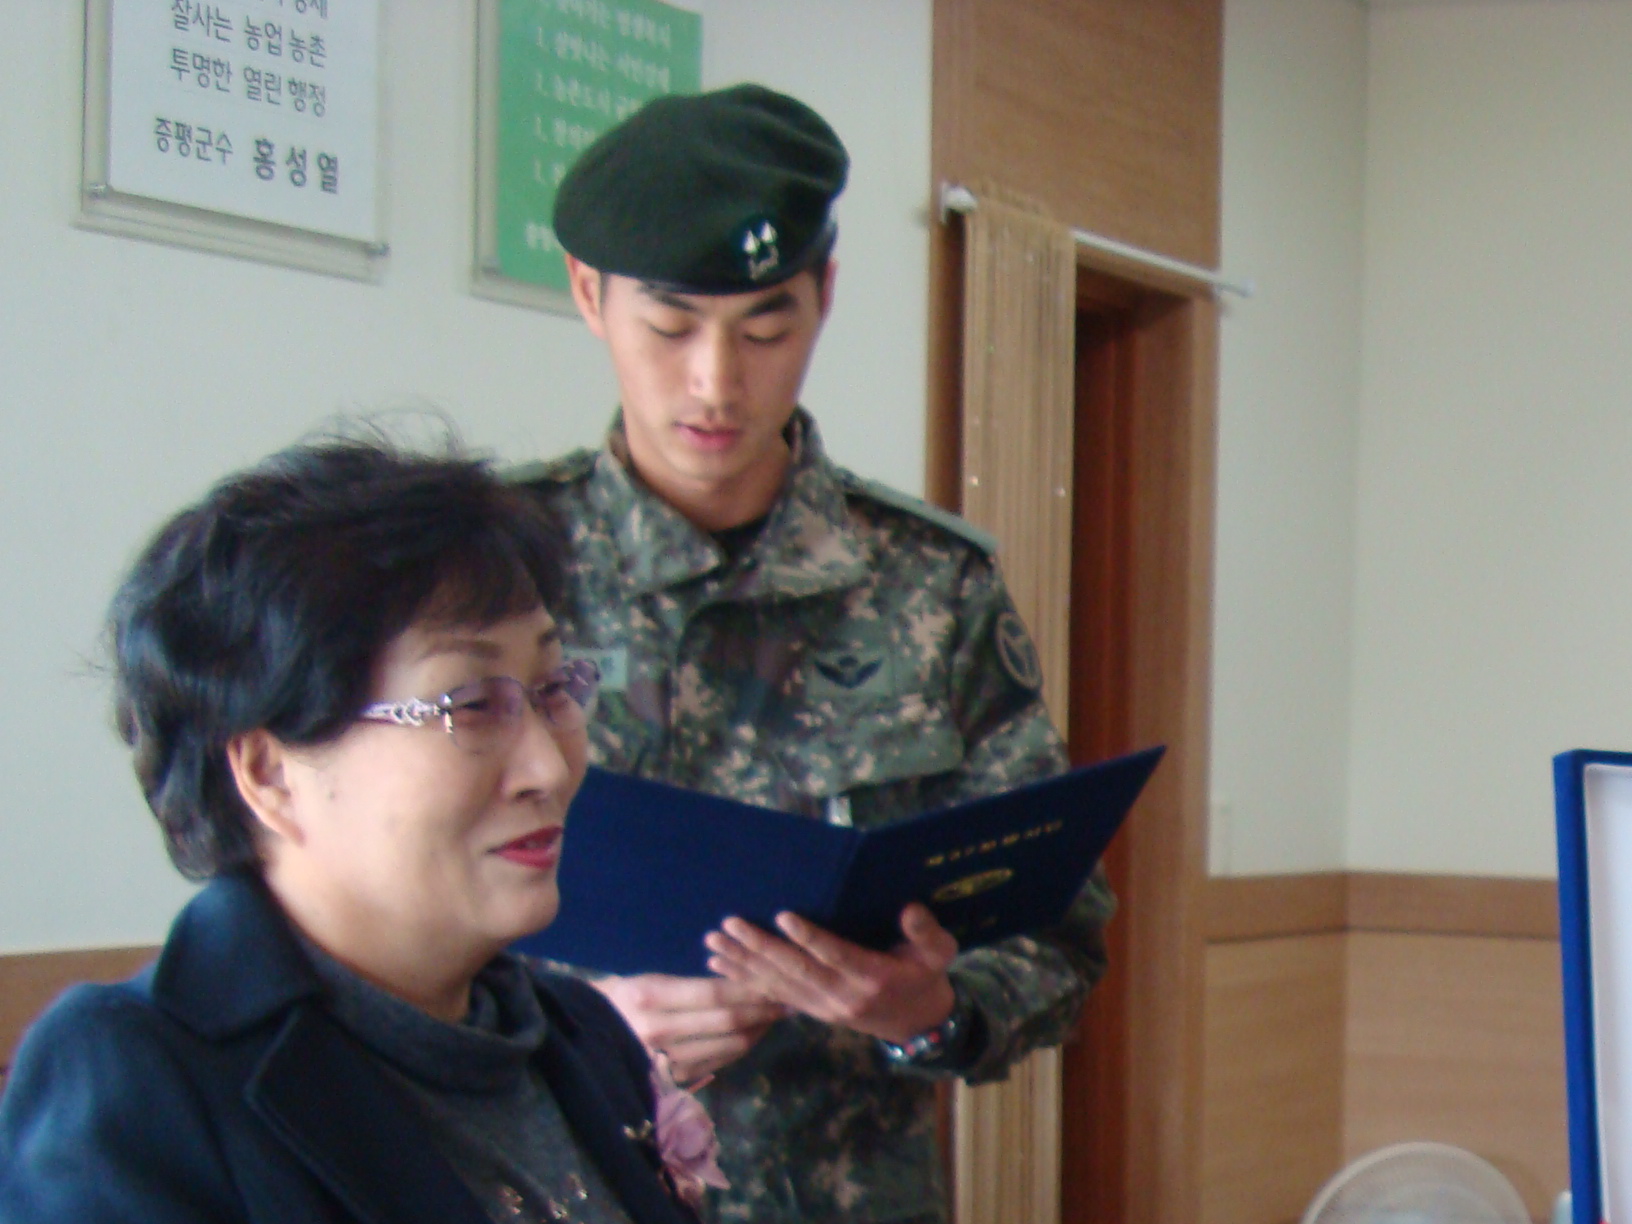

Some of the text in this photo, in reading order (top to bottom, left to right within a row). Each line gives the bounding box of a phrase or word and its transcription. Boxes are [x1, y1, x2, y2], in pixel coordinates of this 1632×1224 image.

[171, 0, 326, 69] 잘사는 농업 농촌
[170, 48, 327, 118] 투명한 열린 행정
[154, 118, 233, 164] 증평군수
